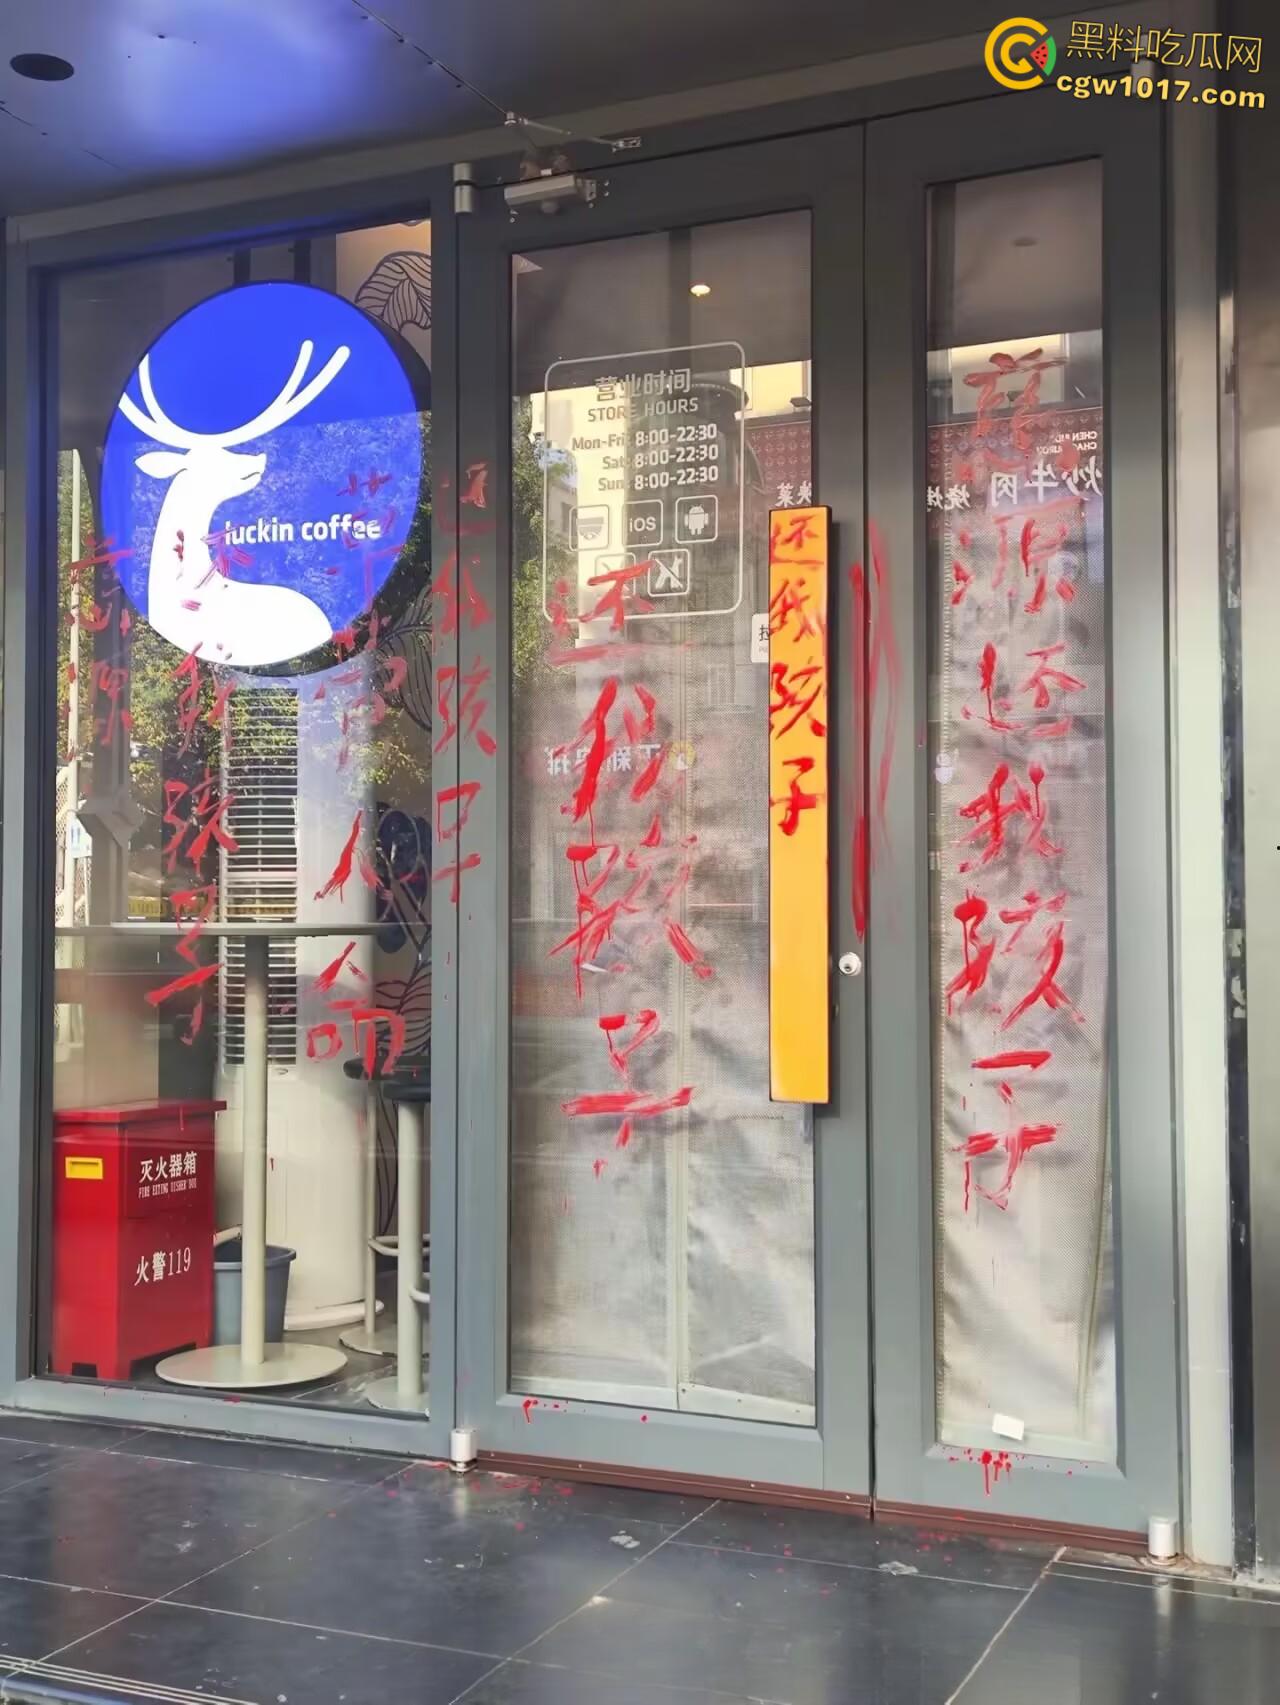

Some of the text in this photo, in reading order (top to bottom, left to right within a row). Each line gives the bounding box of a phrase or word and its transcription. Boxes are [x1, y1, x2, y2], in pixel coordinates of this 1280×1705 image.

[594, 368, 691, 402] 营业时间
[587, 397, 699, 423] STORE HOURS
[634, 423, 718, 447] 8:00-22:30
[634, 444, 719, 469] 8:00-22:30
[634, 465, 719, 491] 8:00-22:30
[225, 513, 382, 546] luckin coffee
[628, 516, 657, 533] iOS
[769, 511, 827, 837] 还我孩子
[138, 1150, 198, 1184] 灭火器箱
